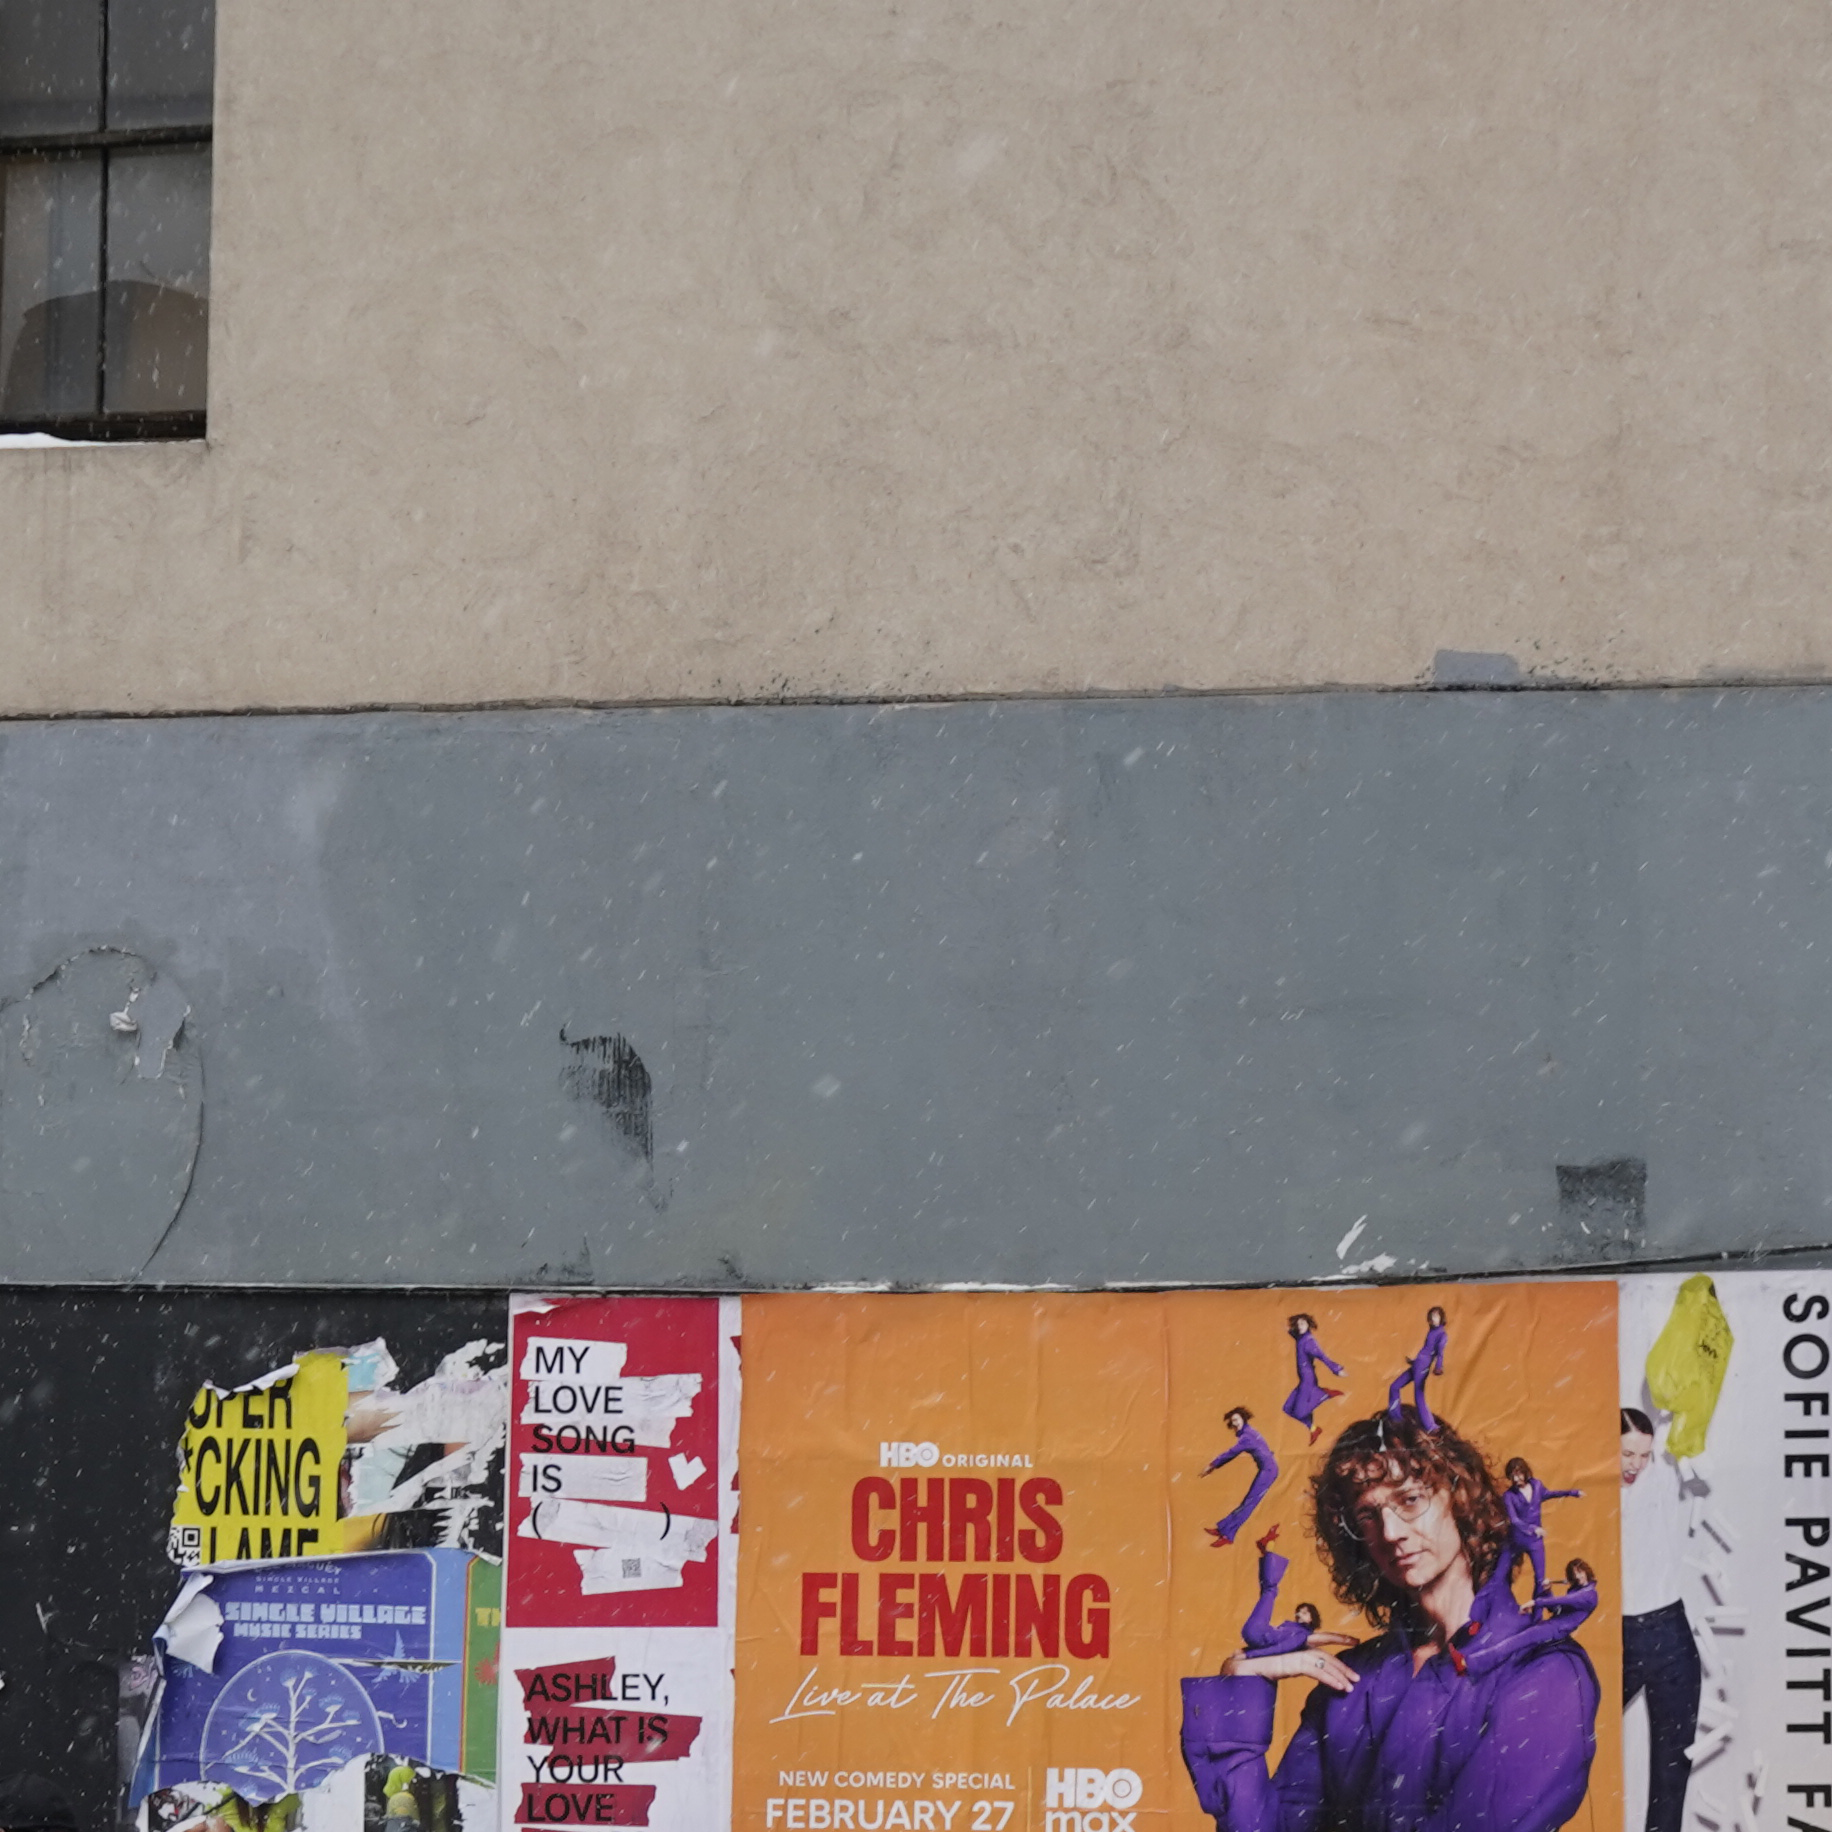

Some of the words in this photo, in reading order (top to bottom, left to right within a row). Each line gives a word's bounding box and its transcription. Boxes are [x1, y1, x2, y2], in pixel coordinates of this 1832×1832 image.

[535, 1347, 589, 1374] MY
[534, 1386, 623, 1414] LOVE
[1783, 1293, 1830, 1478] SOFIE
[532, 1425, 636, 1454] SONG
[879, 1441, 939, 1468] HBO
[942, 1453, 1033, 1468] ORIGINAL
[532, 1463, 563, 1493] IS
[851, 1477, 1063, 1563] CHRIS
[225, 1602, 315, 1622] SINGLE
[319, 1603, 426, 1625] VILLAGE
[800, 1572, 1111, 1659] FLEMING
[233, 1623, 292, 1639] MUSIC
[295, 1624, 363, 1640] SERIES
[1784, 1517, 1832, 1746] PAVITT
[526, 1673, 670, 1706] ASHLEY,
[769, 1666, 862, 1723] Live
[860, 1682, 917, 1710] at
[925, 1668, 1000, 1719] The
[1006, 1664, 1140, 1726] Palace
[527, 1714, 622, 1745] WHAT
[638, 1714, 670, 1743] IS
[527, 1755, 624, 1784] YOUR
[779, 1770, 827, 1787] NEW
[834, 1770, 925, 1789] COMEDY
[932, 1772, 1015, 1790] SPECIAL
[1045, 1767, 1143, 1809] HBO
[526, 1795, 614, 1823] LOVE
[766, 1798, 961, 1831] FEBRUARY
[971, 1801, 1015, 1832] 27
